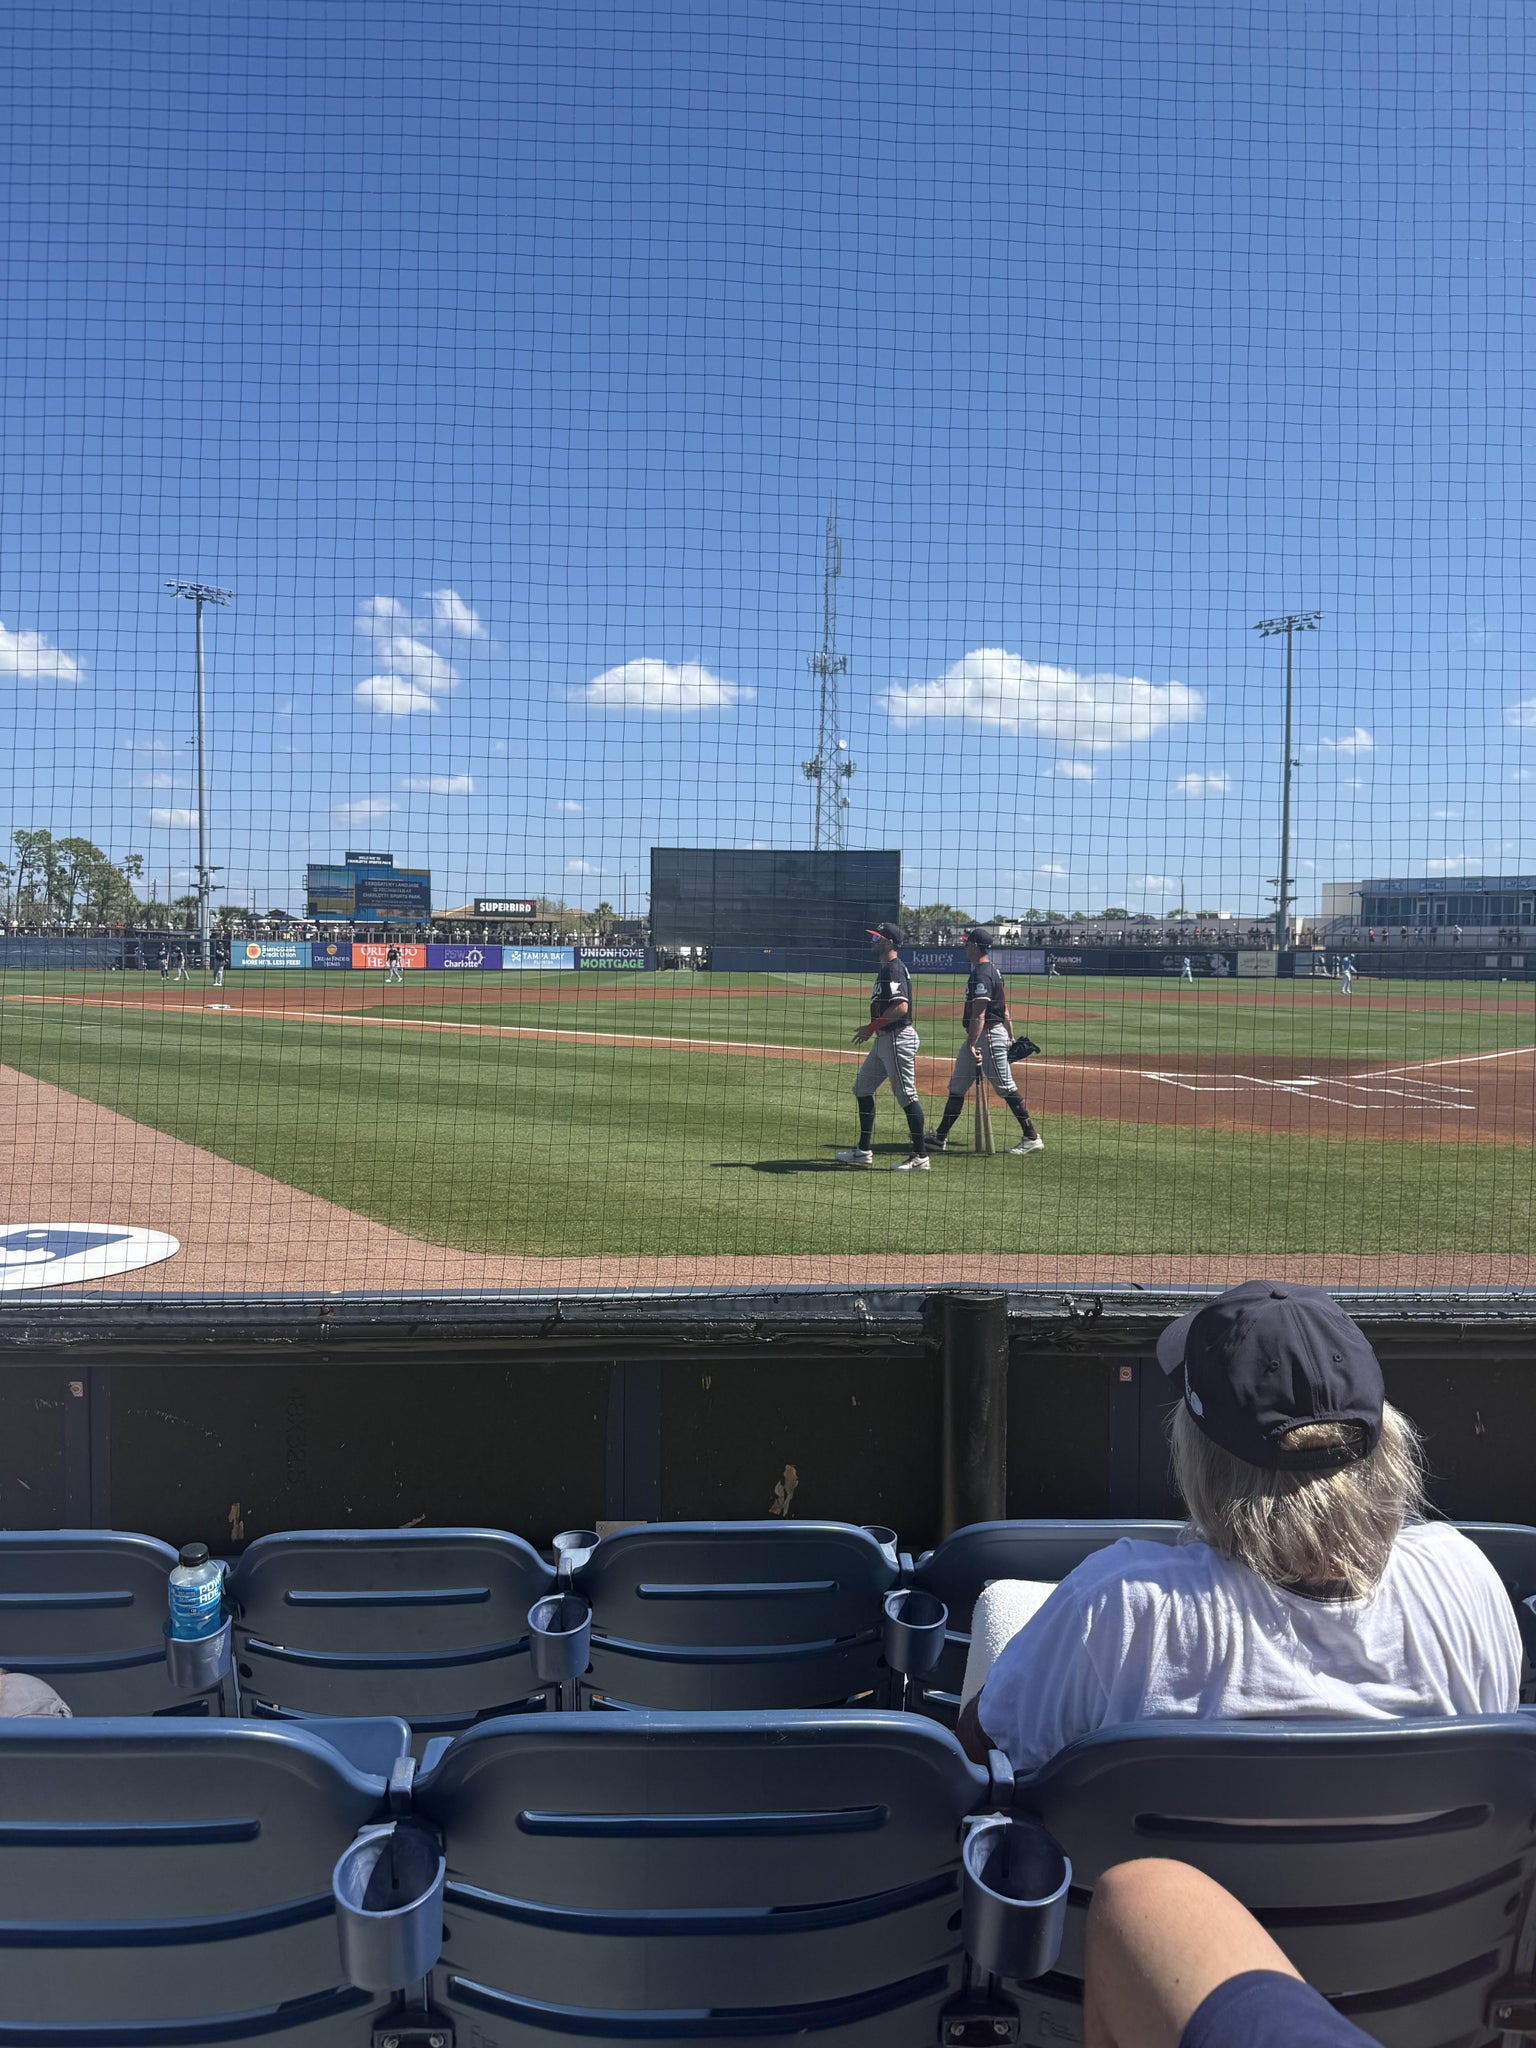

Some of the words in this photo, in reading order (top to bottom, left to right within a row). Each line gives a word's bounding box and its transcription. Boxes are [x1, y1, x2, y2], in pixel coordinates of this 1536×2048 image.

[479, 902, 532, 913] SUPERBIRD
[261, 945, 296, 953] Suncoast
[522, 952, 549, 960] TAMPA
[550, 952, 565, 960] BAY
[444, 959, 479, 968] Charlotte
[580, 958, 645, 968] MORTGAGE
[199, 1588, 219, 1604] ADE
